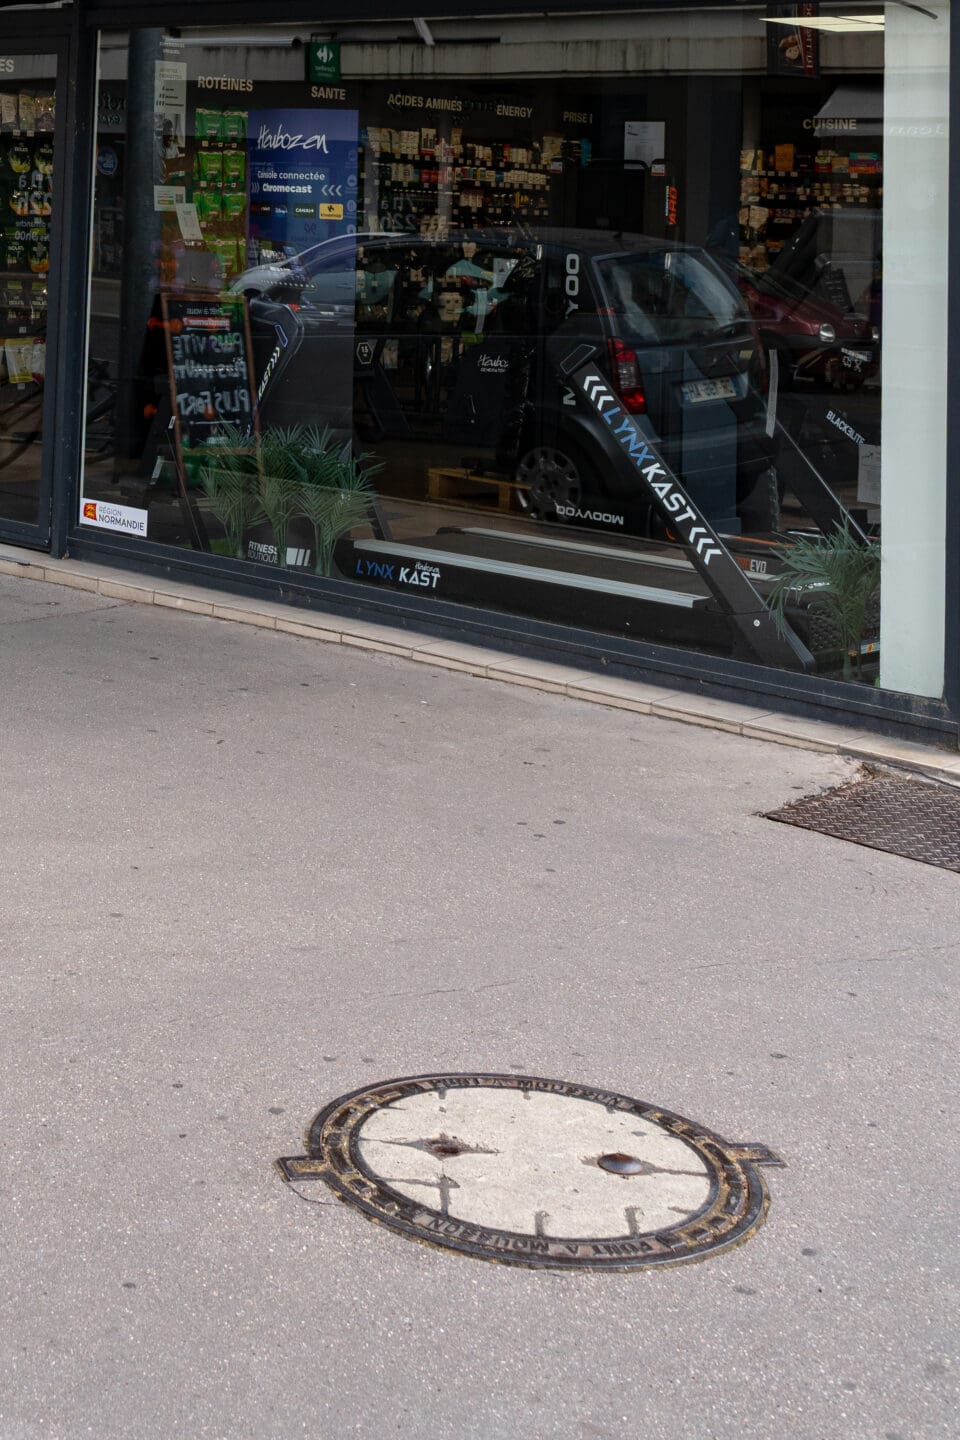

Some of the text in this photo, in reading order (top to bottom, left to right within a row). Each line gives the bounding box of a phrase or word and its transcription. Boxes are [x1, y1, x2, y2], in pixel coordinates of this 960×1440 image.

[387, 93, 423, 108] ACIDES
[496, 104, 533, 119] ENERGY
[602, 406, 697, 523] LYNX KAST
[97, 505, 123, 517] RÉGION
[97, 514, 146, 531] NORMANDIE
[356, 559, 396, 580] LYNX
[398, 566, 440, 589] KAST
